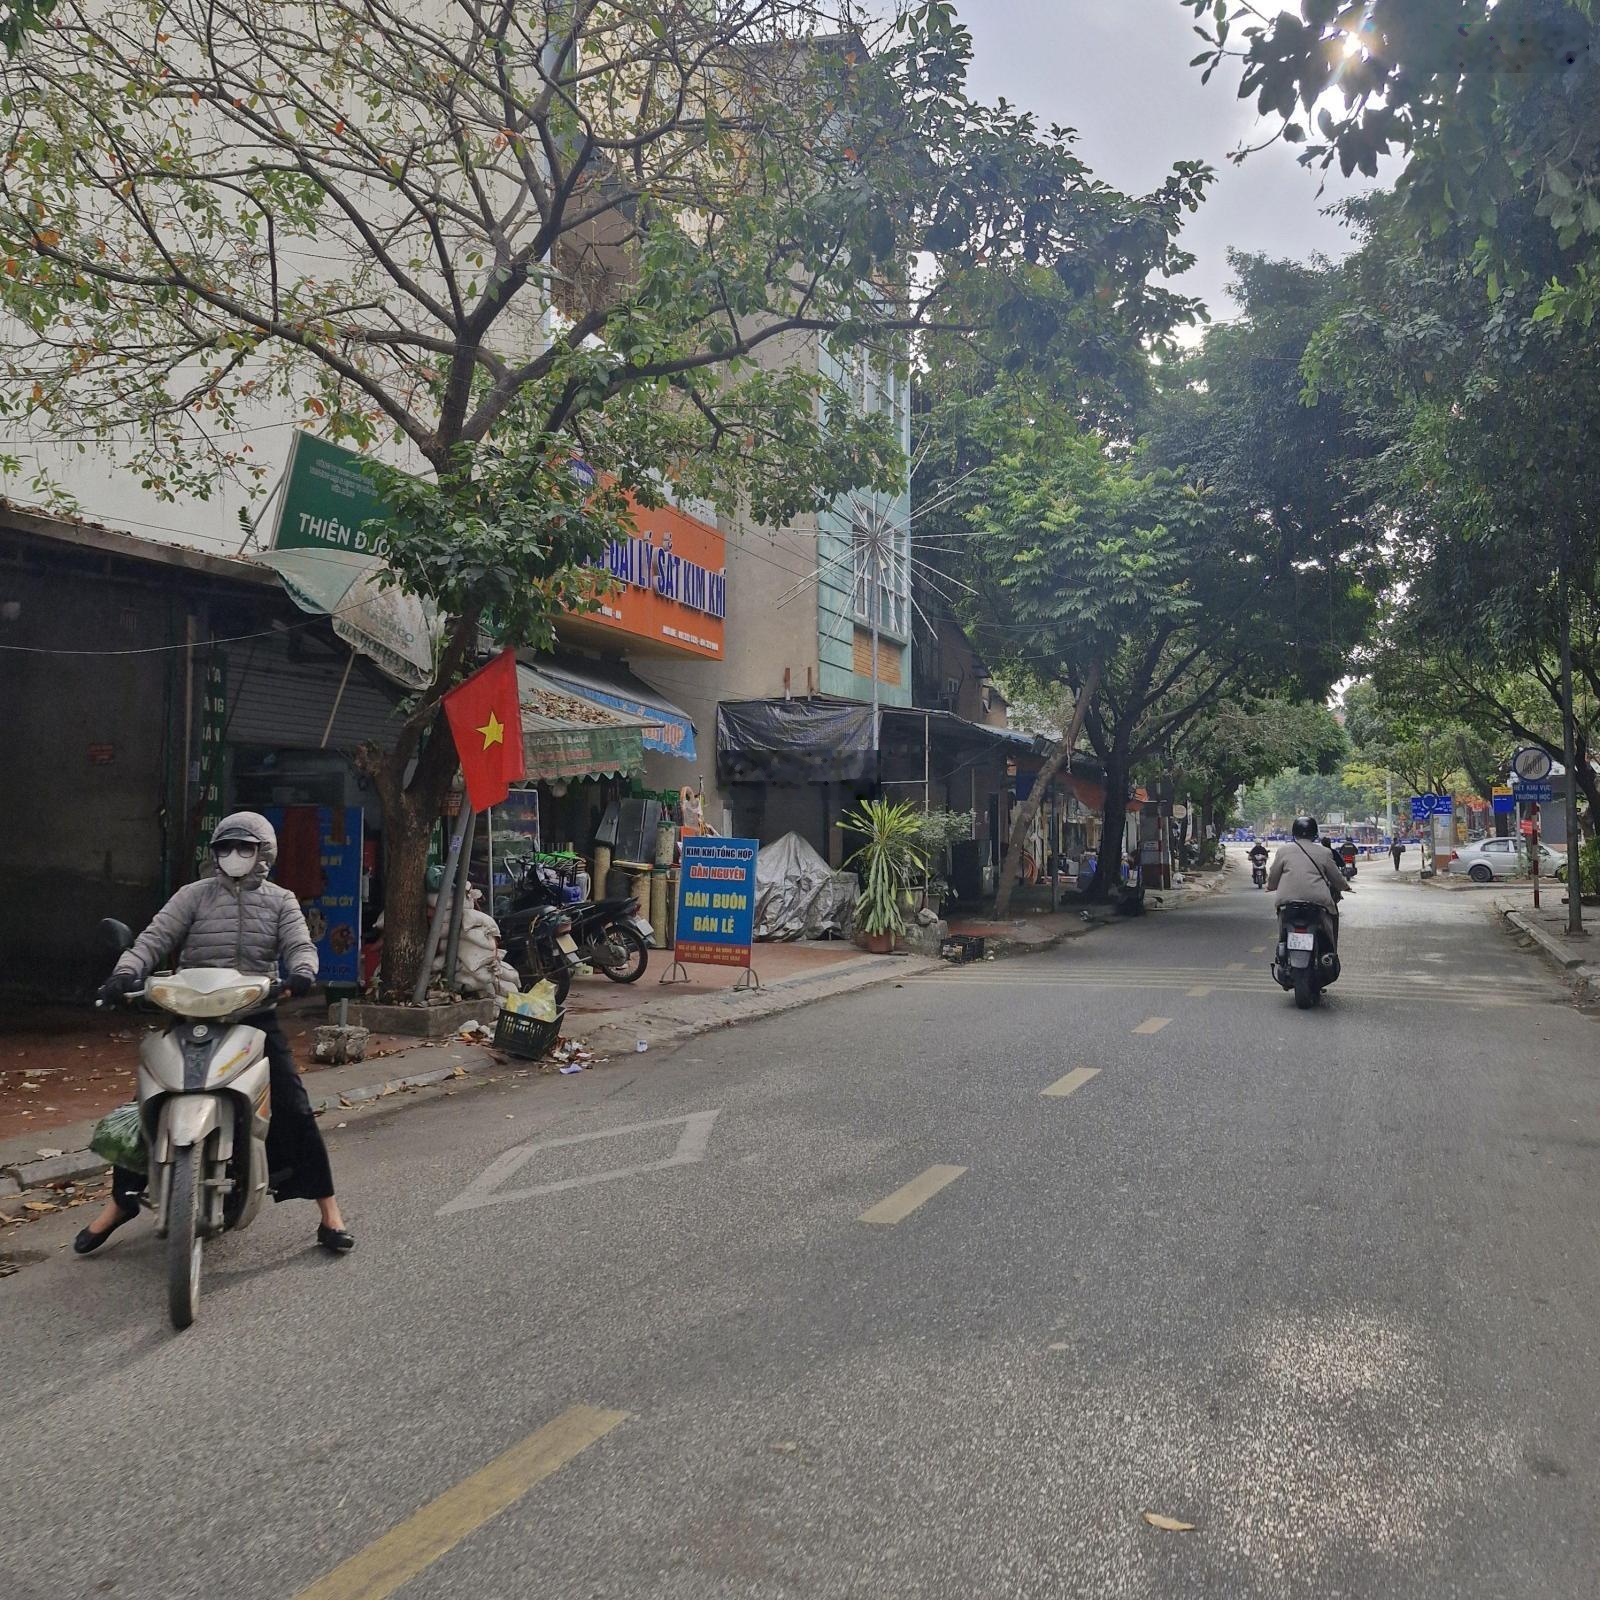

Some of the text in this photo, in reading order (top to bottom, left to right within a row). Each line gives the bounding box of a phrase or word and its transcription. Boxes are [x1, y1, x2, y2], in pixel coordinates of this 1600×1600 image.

[299, 512, 351, 546] THIÊN
[637, 530, 654, 590] LÝ
[657, 531, 681, 600] SẮT
[683, 559, 706, 611] KIM
[708, 567, 727, 619] KHÍ
[686, 847, 700, 857] KIM
[701, 847, 715, 858] KHÍ
[737, 848, 753, 861] HỢP
[710, 866, 746, 880] NGUYÊN
[685, 890, 747, 910] BÁN BUÔN
[693, 914, 718, 933] BÁN
